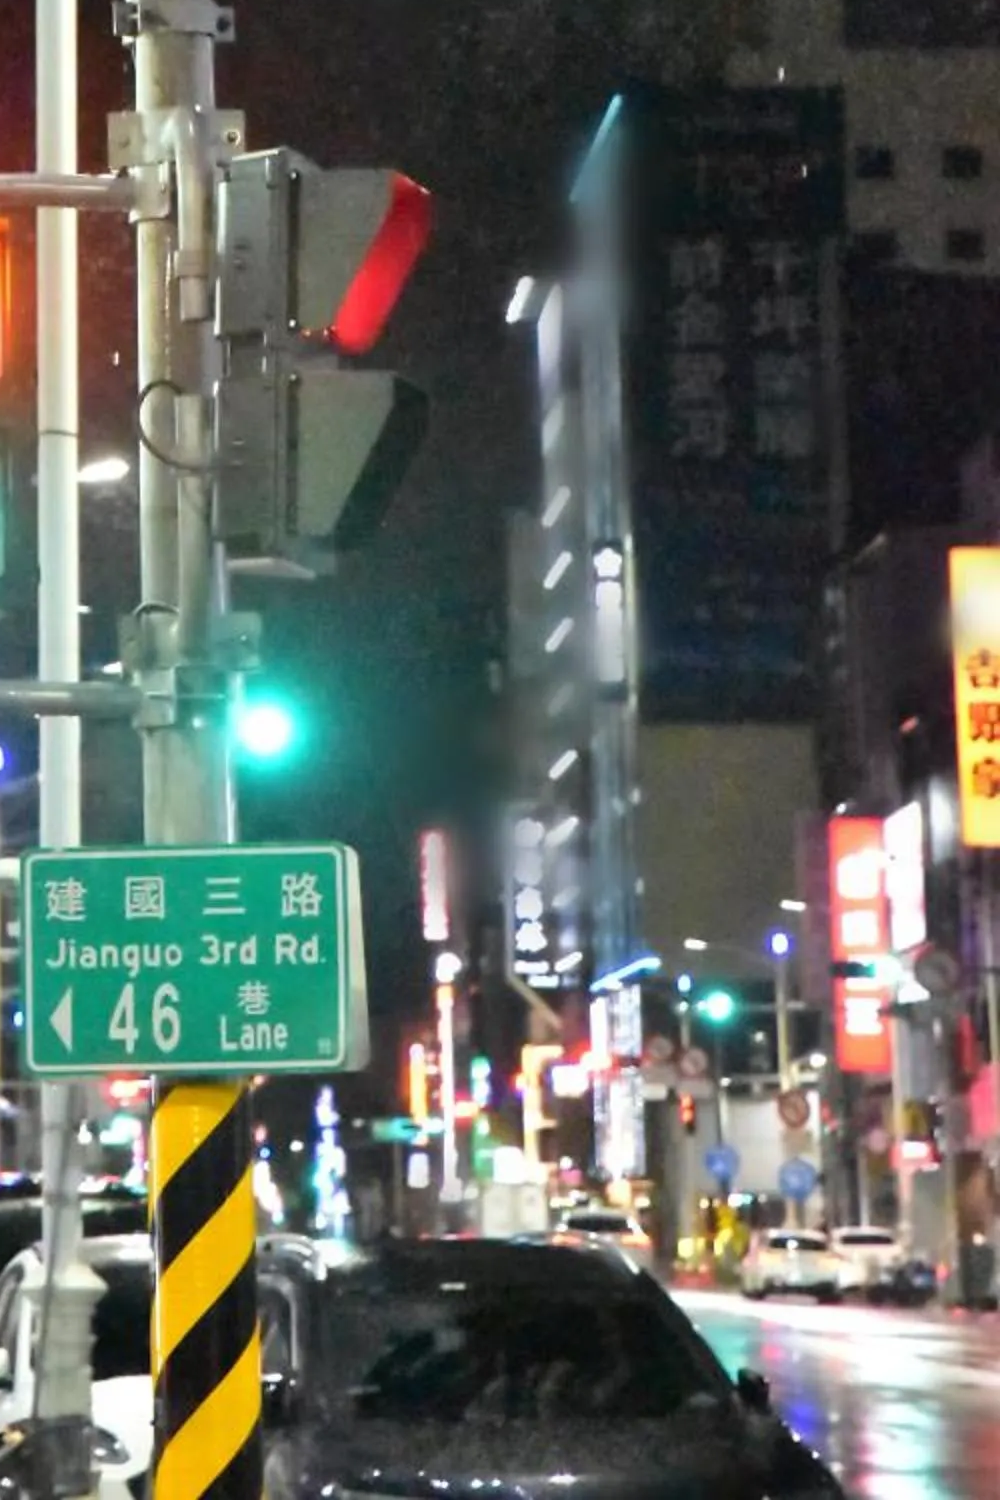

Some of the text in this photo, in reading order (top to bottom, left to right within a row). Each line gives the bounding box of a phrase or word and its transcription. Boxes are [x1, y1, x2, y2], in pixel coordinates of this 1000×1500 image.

[45, 873, 324, 921] 建國三路
[46, 933, 328, 978] Jianguo 3rd Rd.
[108, 981, 182, 1054] 46
[236, 980, 271, 1016] 巷
[219, 1014, 288, 1051] Lane
